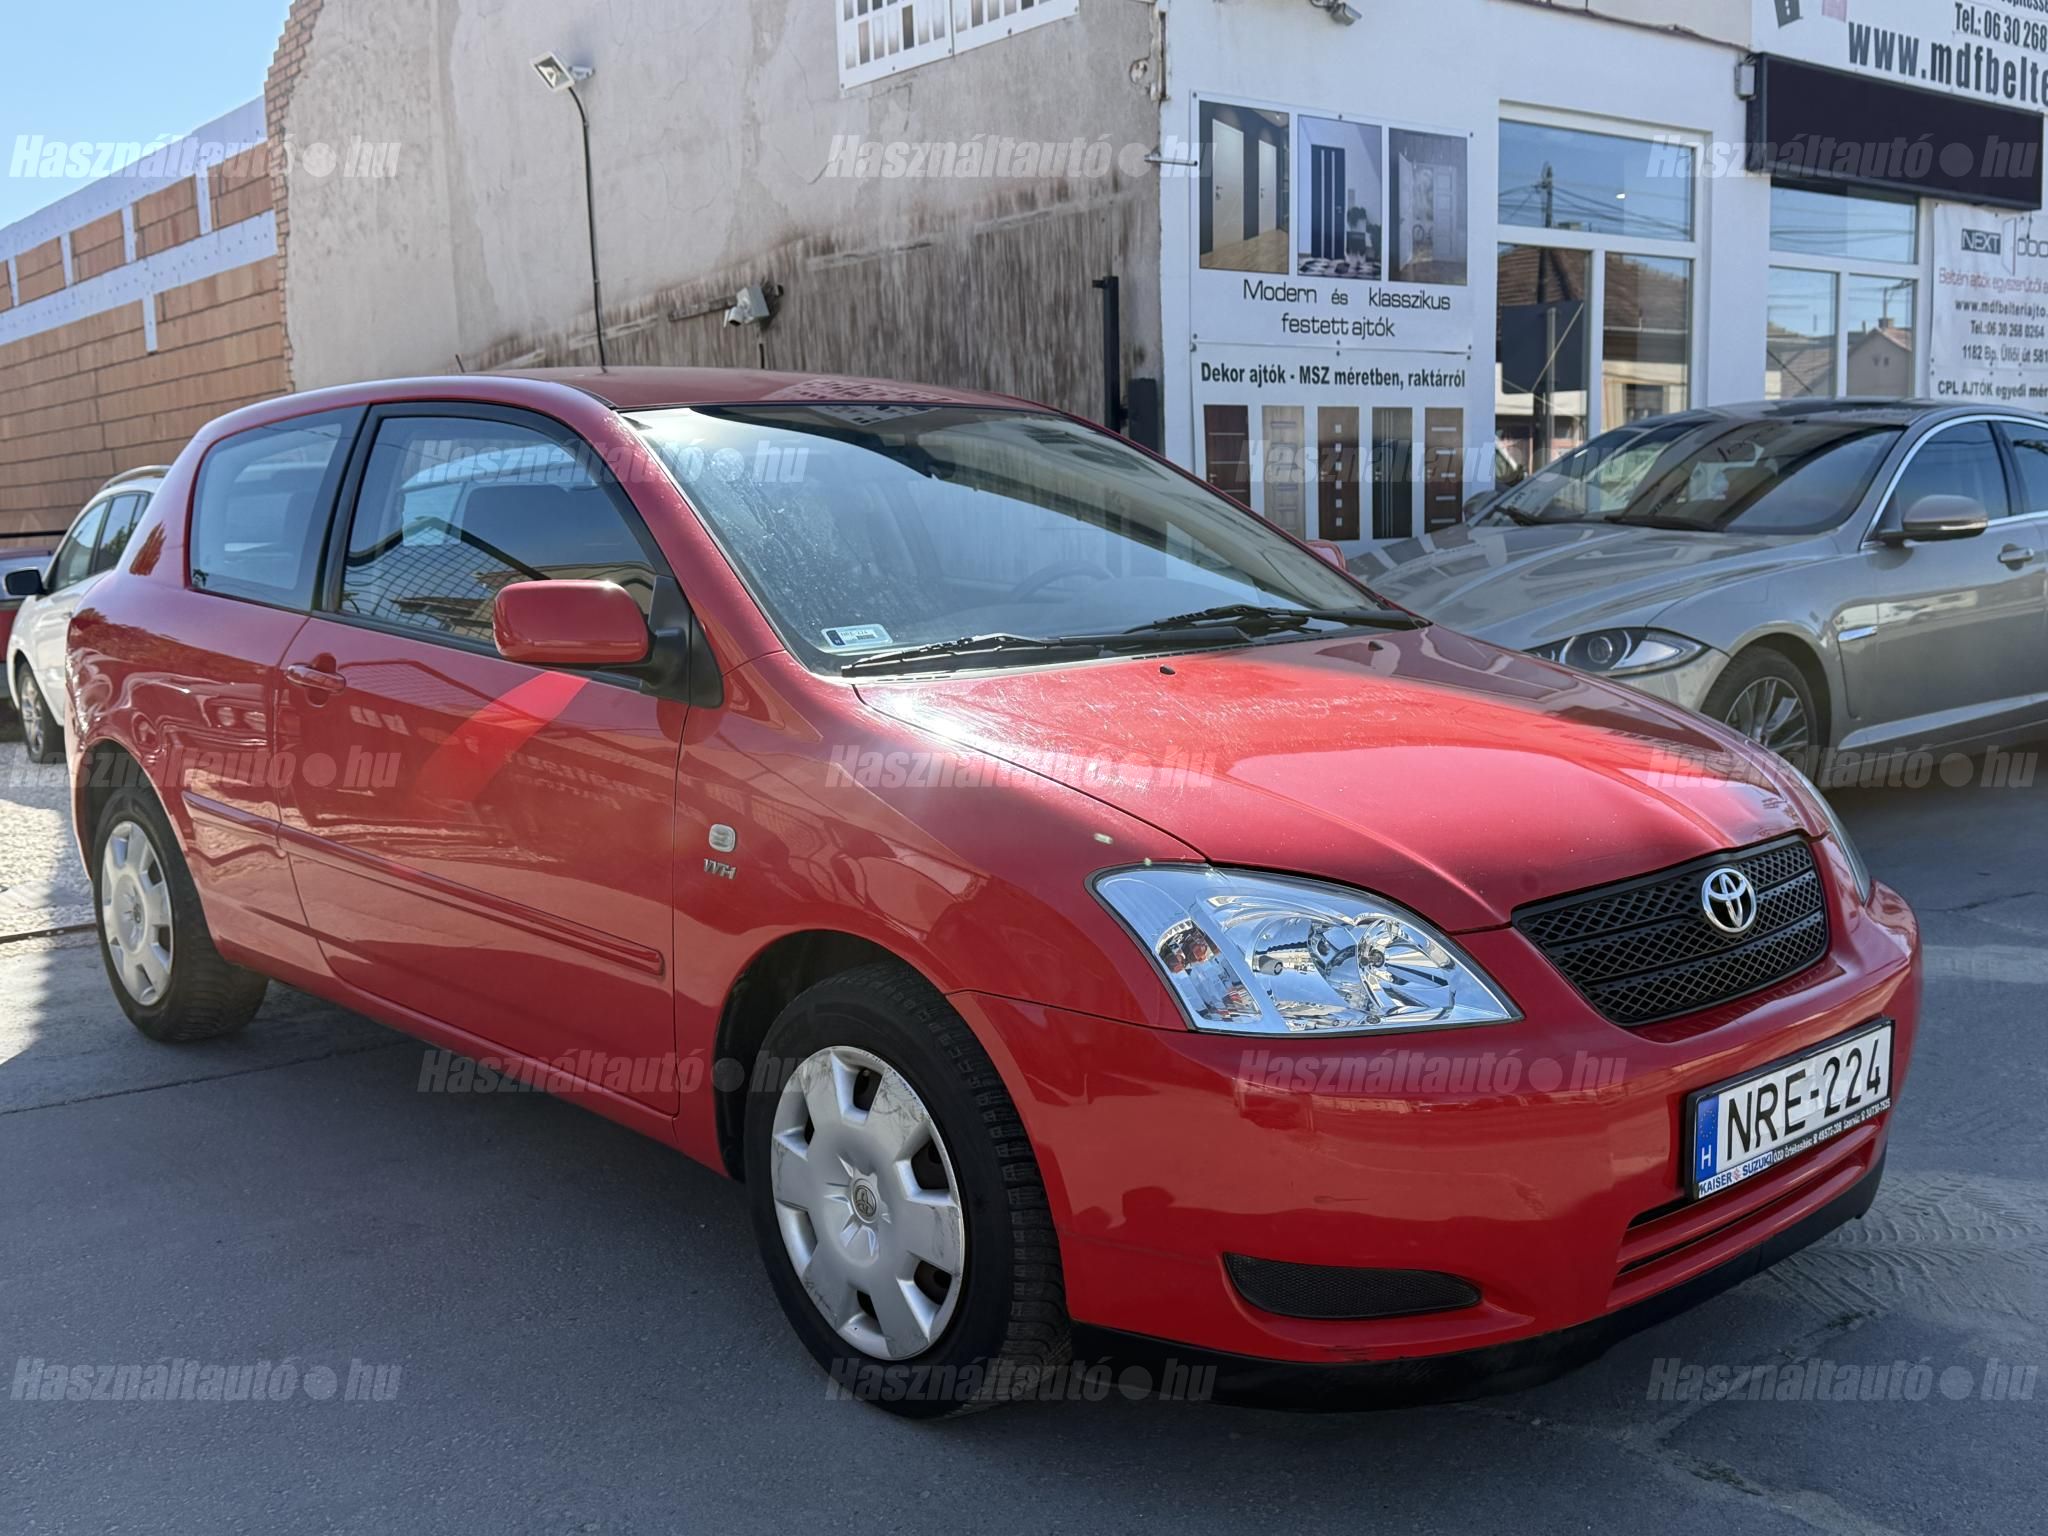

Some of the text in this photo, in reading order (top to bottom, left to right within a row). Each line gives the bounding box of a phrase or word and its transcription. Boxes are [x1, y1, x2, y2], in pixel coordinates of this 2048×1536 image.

[1984, 10, 2000, 41] 06
[2004, 15, 2020, 46] 30
[2023, 21, 2047, 52] 268
[1962, 230, 2001, 254] NEXT
[1243, 279, 1451, 311] Modern és klasszikus
[1281, 313, 1396, 340] festett ajtók
[1963, 344, 1982, 361] 1182
[1200, 362, 1245, 383] Dekor
[1249, 364, 1286, 388] ajtók
[1299, 365, 1330, 385] MSZ
[1334, 367, 1404, 391] méretben,
[1408, 369, 1466, 388] raktárról
[1938, 380, 1959, 395] CPL
[1961, 378, 1993, 397] AJTÓK
[1996, 384, 2026, 401] egyedi
[1726, 1038, 1881, 1161] NRE-224
[1701, 1144, 1712, 1170] H
[1699, 1171, 1733, 1196] KAISER
[1742, 1151, 1773, 1177] SUZUKI
